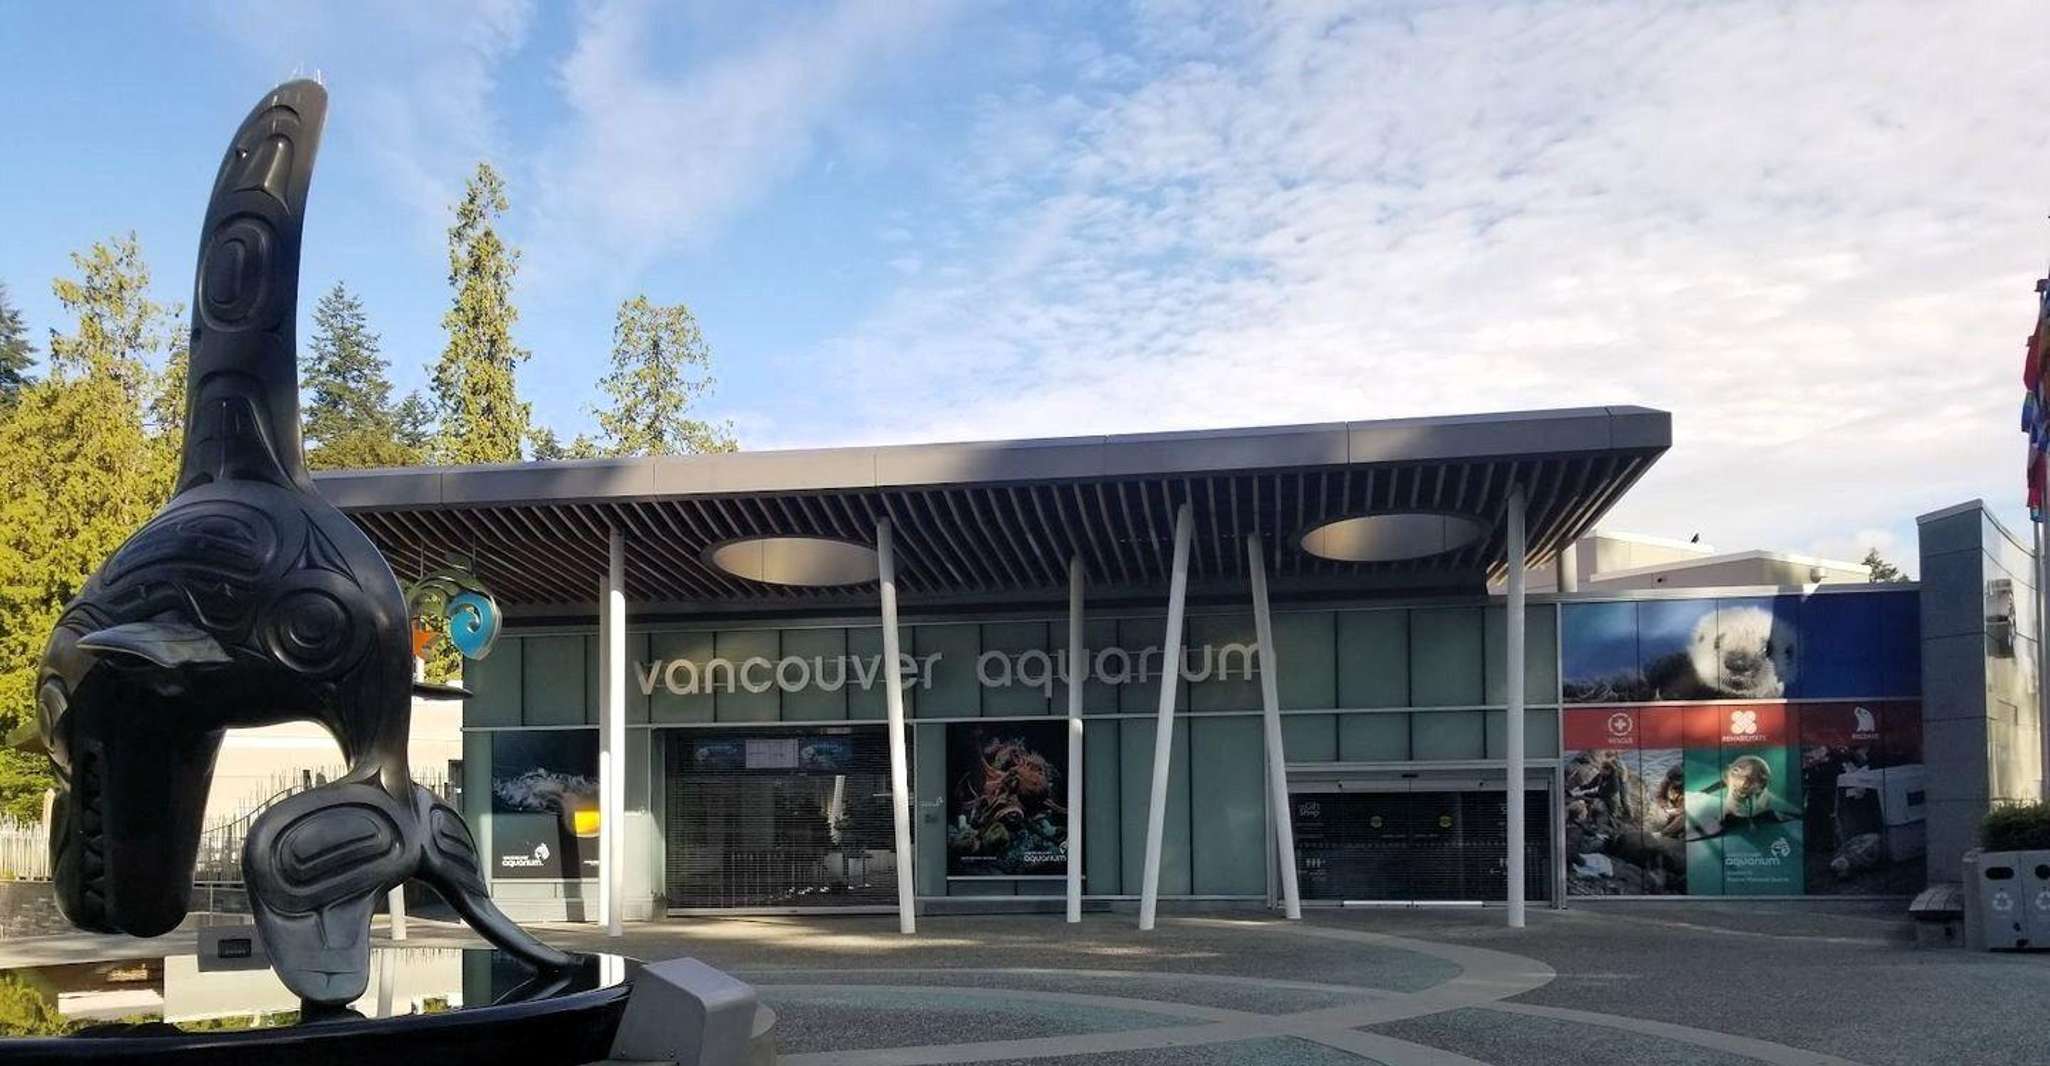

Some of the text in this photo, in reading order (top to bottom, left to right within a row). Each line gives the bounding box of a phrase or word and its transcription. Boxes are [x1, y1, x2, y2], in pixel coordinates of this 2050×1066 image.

[633, 641, 1276, 698] vancouver aquarum
[1724, 856, 1780, 867] aquarium
